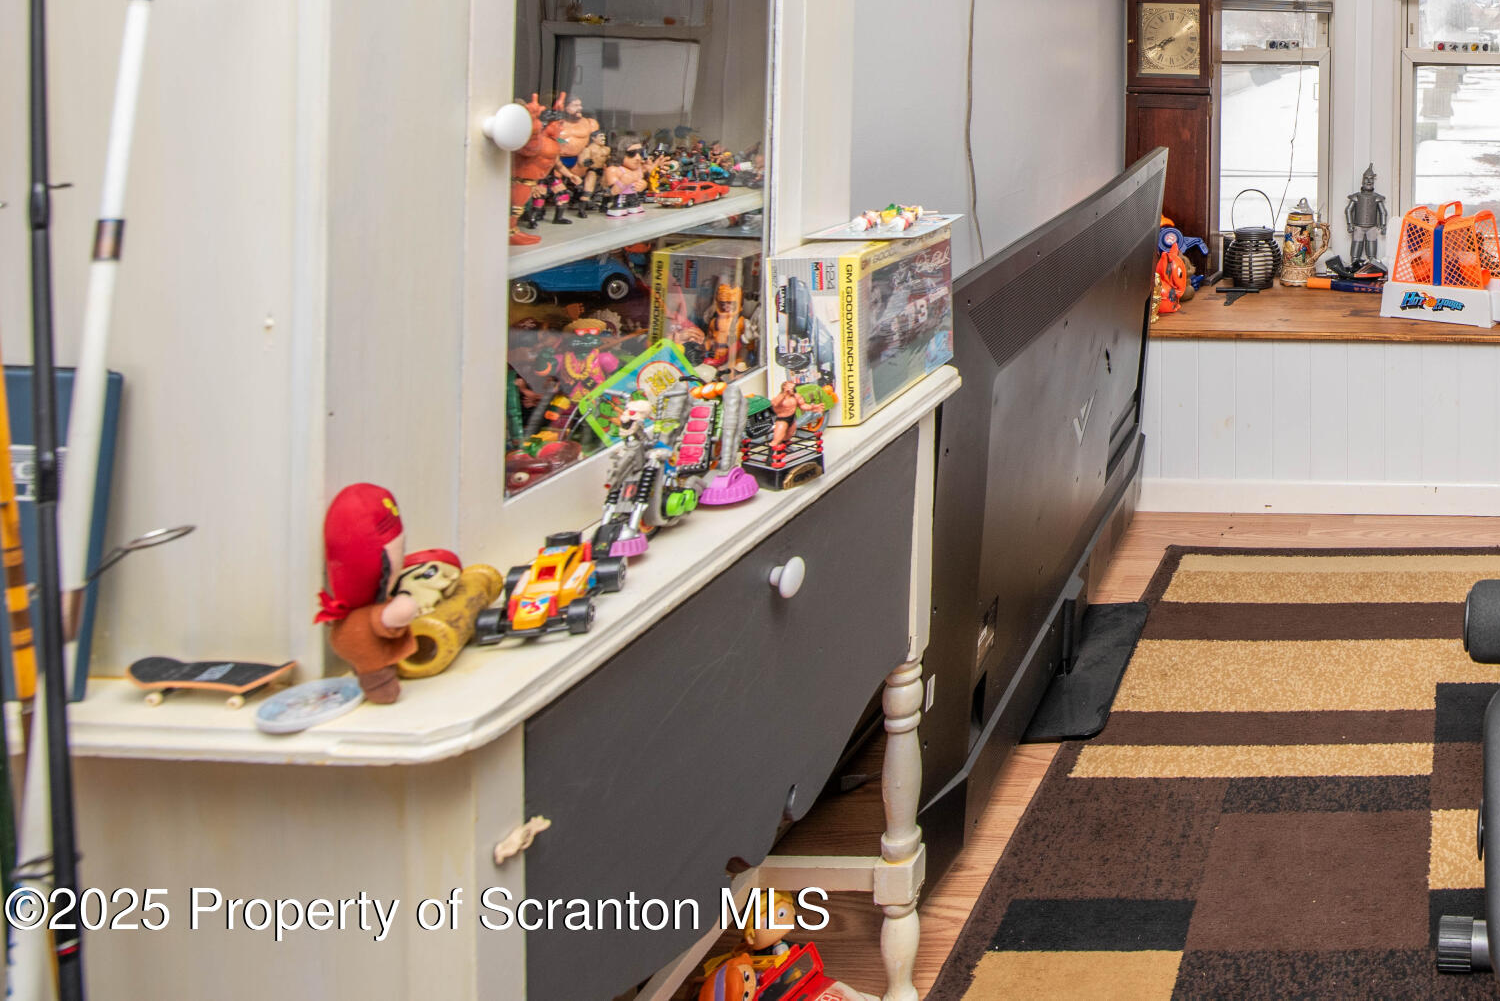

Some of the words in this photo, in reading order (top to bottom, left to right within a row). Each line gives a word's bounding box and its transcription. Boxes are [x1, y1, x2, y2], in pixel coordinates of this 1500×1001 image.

[845, 263, 853, 284] GM
[1400, 291, 1426, 311] HOT
[845, 285, 854, 377] GOODWRENCH
[846, 378, 855, 421] LUMINA
